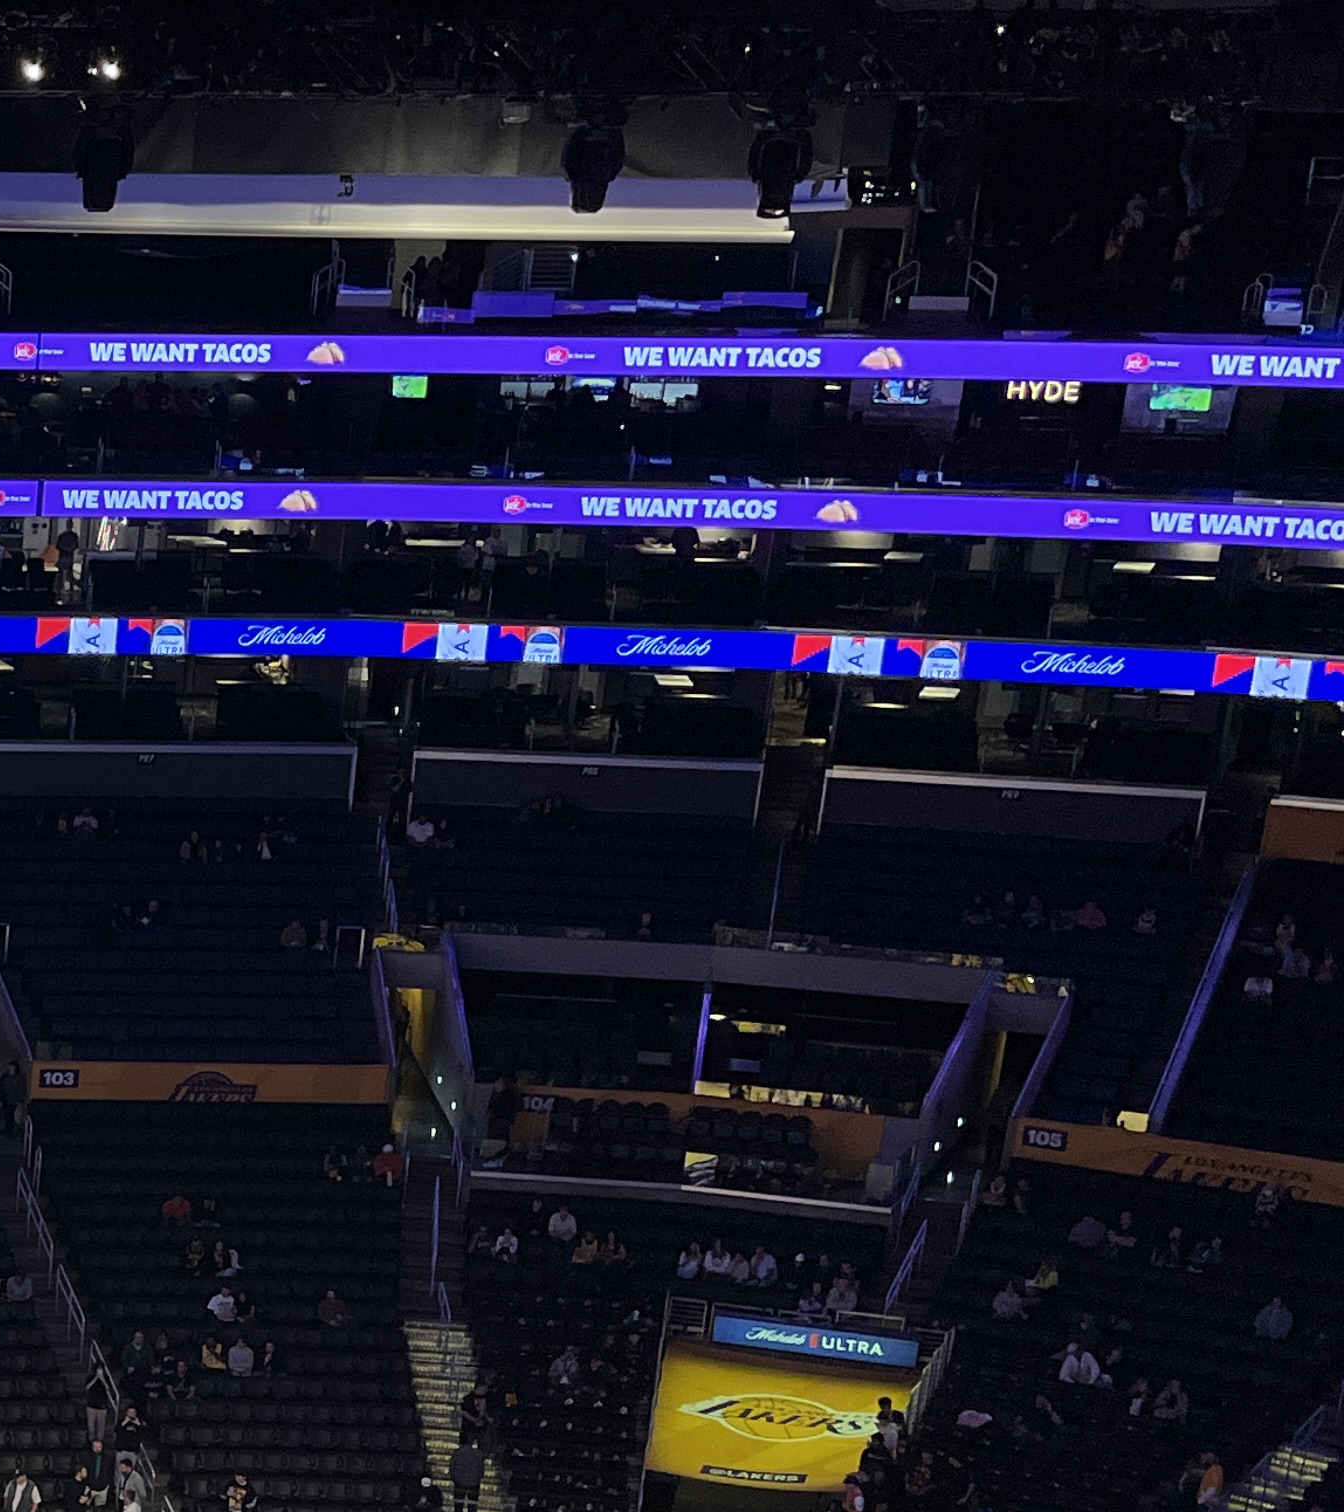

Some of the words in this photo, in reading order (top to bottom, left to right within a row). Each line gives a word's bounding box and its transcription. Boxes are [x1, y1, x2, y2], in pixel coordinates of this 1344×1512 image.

[90, 342, 126, 362] WE
[130, 343, 199, 363] WANT
[202, 343, 271, 364] TACOS
[624, 346, 664, 367] WE
[668, 347, 743, 368] WANT
[746, 347, 822, 368] TACOS
[1212, 355, 1255, 377] WE
[1259, 356, 1341, 379] WANT
[1007, 380, 1081, 402] HYDE
[63, 489, 100, 509] WE
[103, 489, 172, 510] WANT
[175, 490, 244, 510] TACOS
[581, 497, 620, 517] WE
[625, 498, 699, 518] WANT
[702, 499, 778, 520] TACOS
[1151, 511, 1193, 534] WE
[1199, 514, 1280, 537] WANT
[238, 625, 327, 647] Michelob
[616, 634, 713, 657] Michelob
[1020, 650, 1126, 676] Michelob
[43, 1072, 75, 1086] 103
[522, 1096, 555, 1112] 104
[1027, 1129, 1062, 1148] 105
[745, 1327, 806, 1346] Michelob
[821, 1336, 885, 1357] ULTRA
